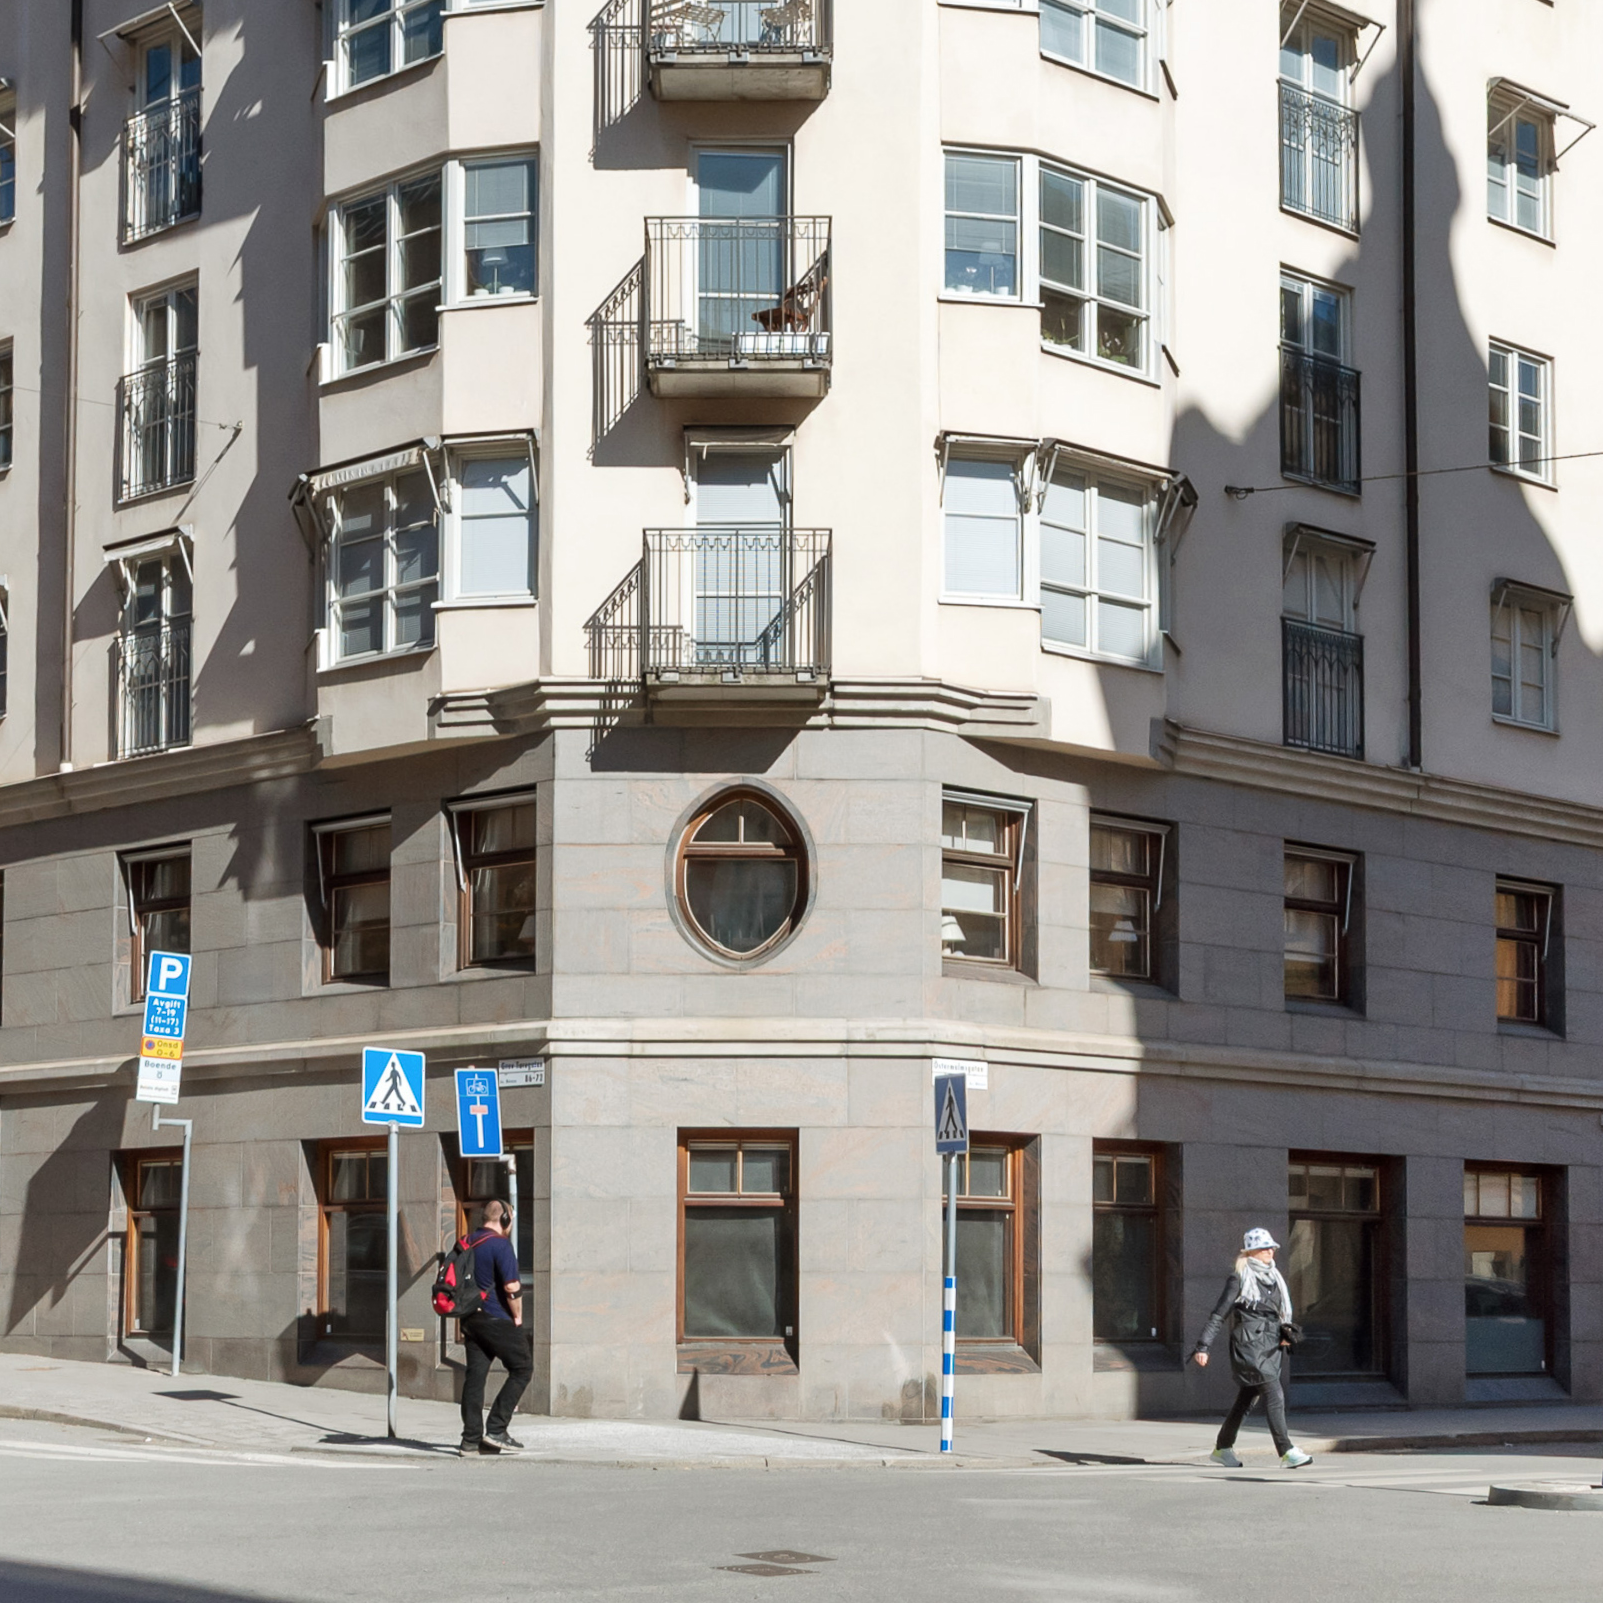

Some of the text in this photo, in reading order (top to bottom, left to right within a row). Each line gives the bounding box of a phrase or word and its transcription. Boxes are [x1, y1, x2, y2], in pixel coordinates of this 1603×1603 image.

[158, 956, 184, 991] P
[152, 997, 181, 1009] Avgift
[156, 1006, 176, 1017] 7-19
[150, 1014, 180, 1027] (11-17)
[149, 1024, 180, 1035] Taxa 3
[157, 1040, 179, 1049] Onsd
[144, 1060, 177, 1070] Boende
[933, 1059, 984, 1074] Östermalmsgatan
